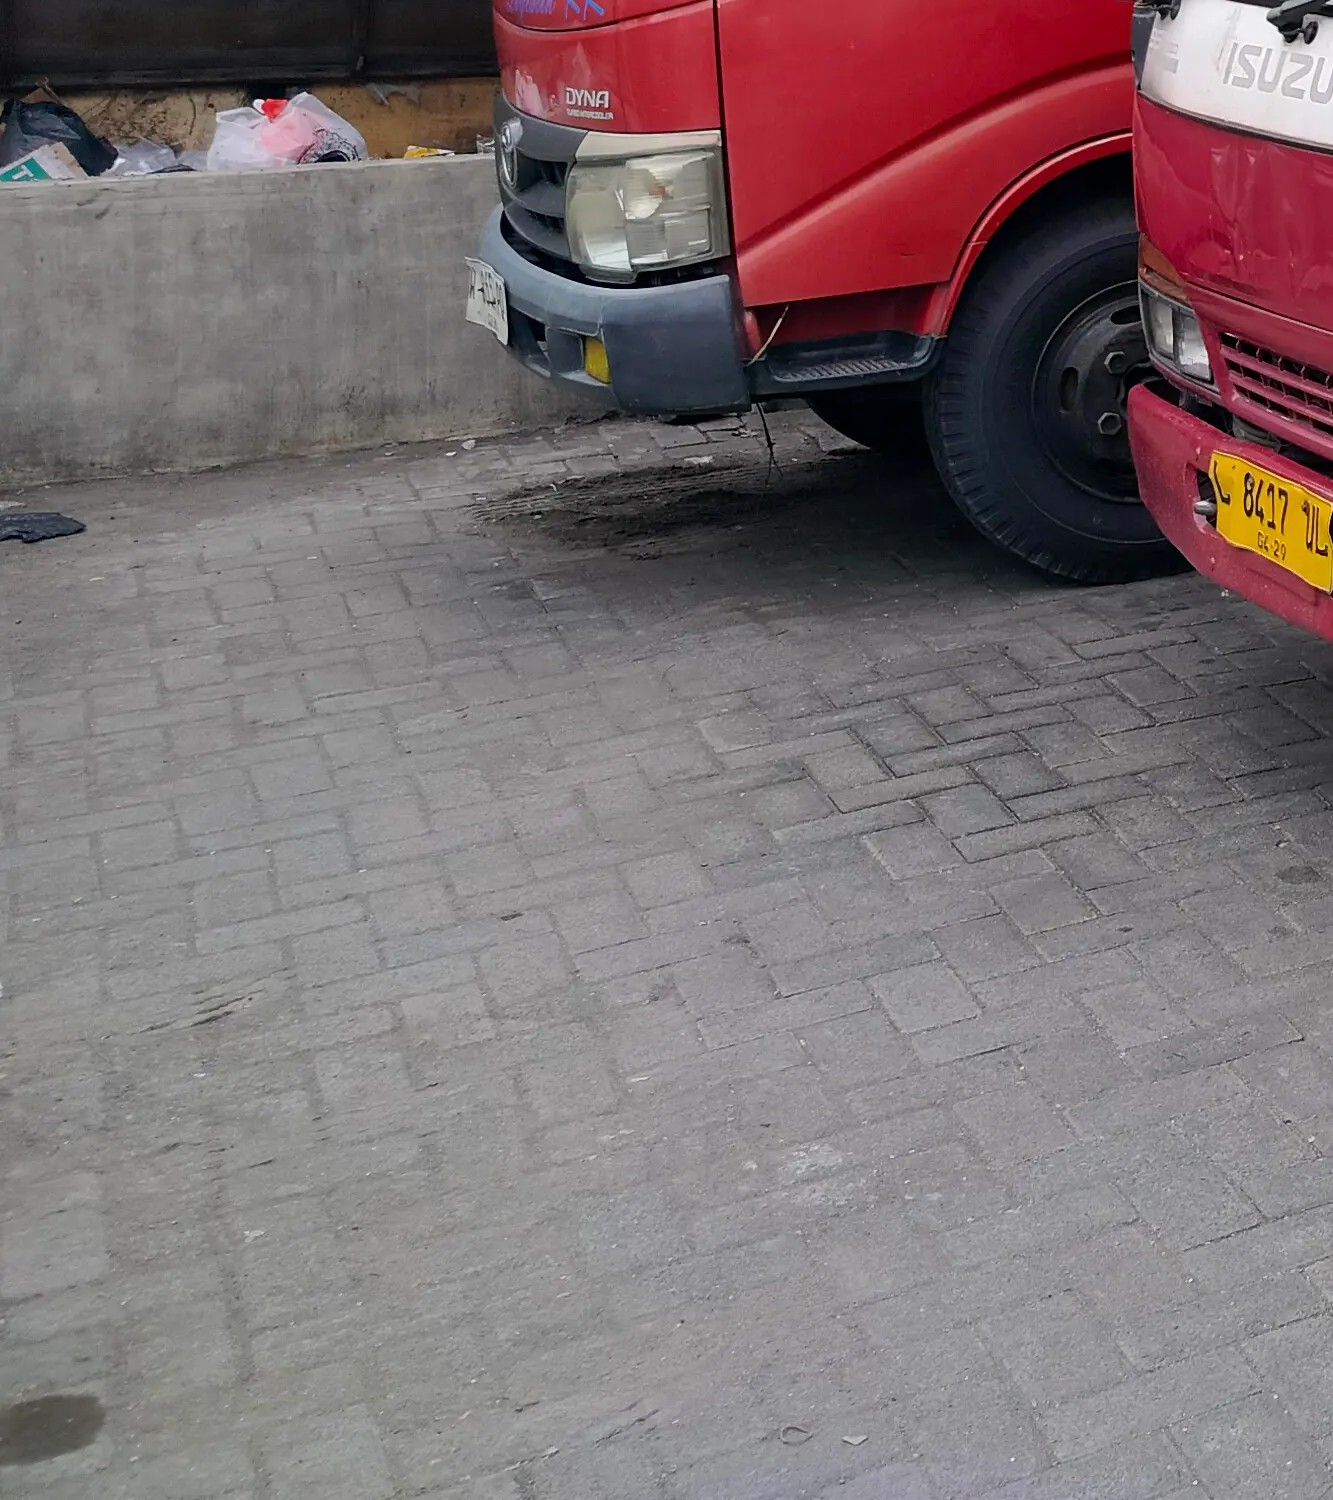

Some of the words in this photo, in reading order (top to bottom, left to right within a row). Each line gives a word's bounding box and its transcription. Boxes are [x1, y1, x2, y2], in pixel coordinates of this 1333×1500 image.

[565, 86, 610, 109] DYNA
[1213, 459, 1232, 506] L
[1243, 471, 1289, 535] 8417
